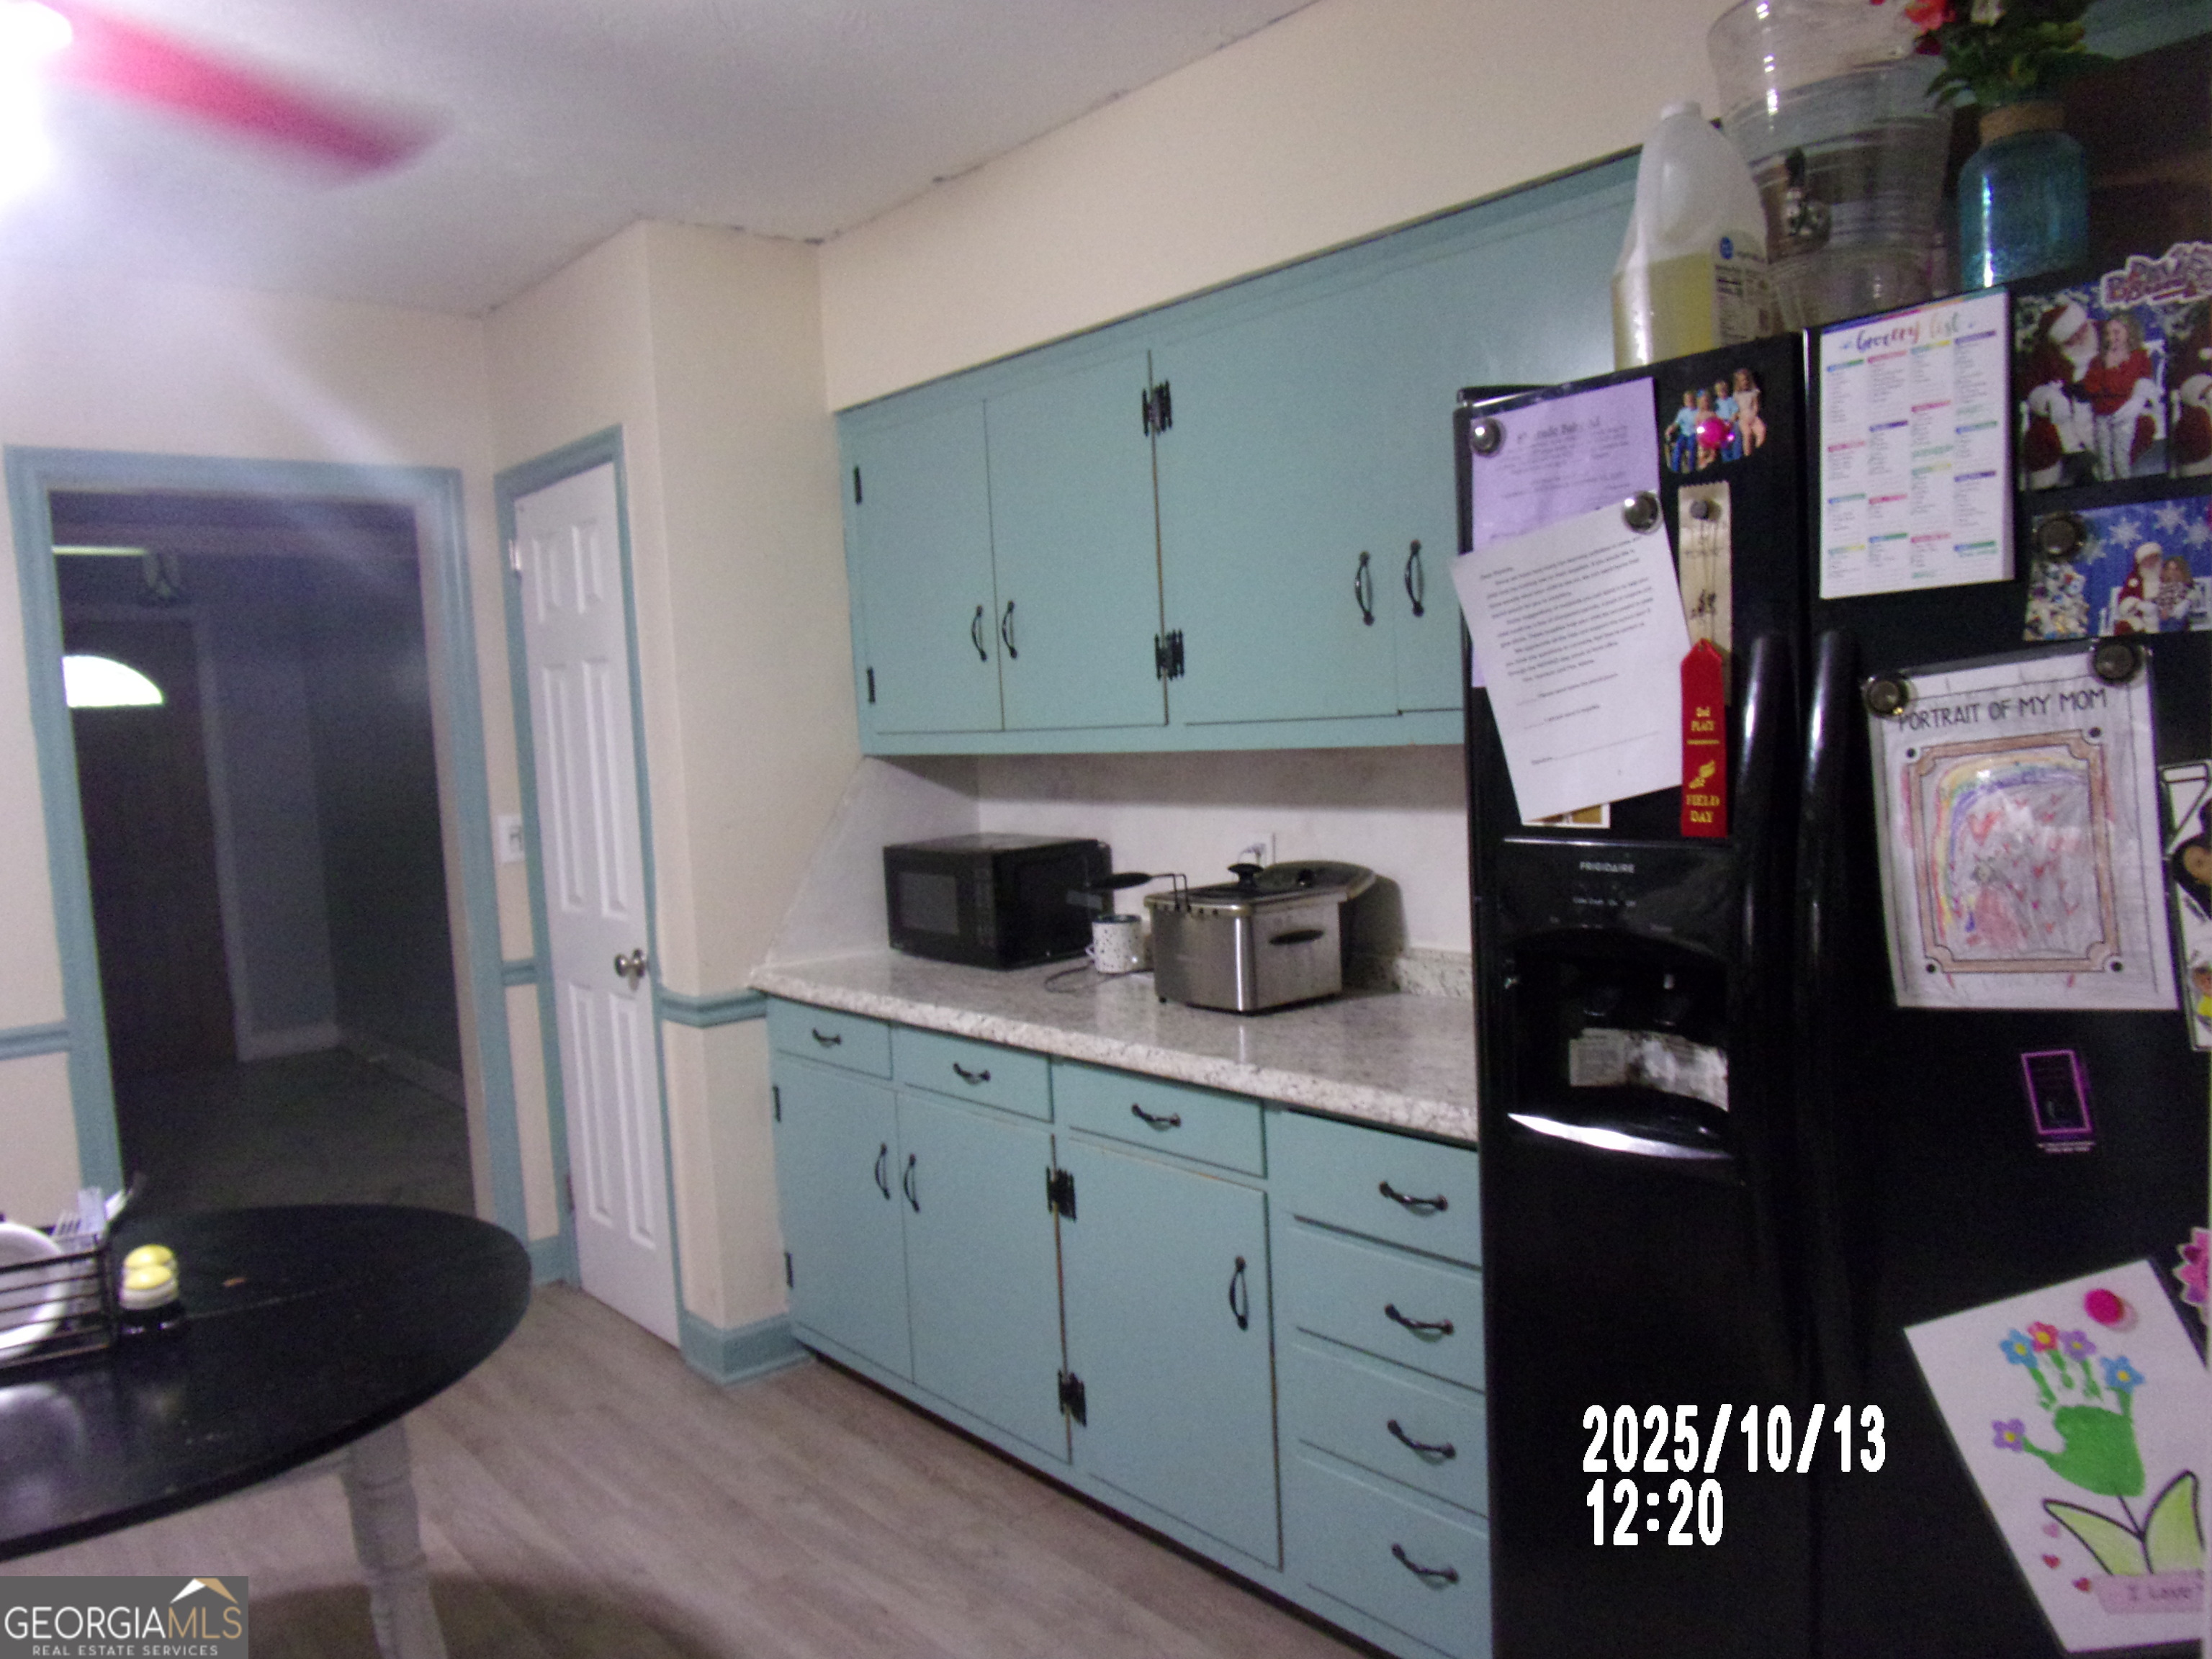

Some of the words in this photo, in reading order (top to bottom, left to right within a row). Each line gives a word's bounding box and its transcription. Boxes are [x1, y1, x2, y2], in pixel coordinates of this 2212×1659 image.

[1899, 703, 1979, 732] PORTRAIT
[1988, 698, 2012, 721] OF
[2019, 693, 2051, 717] MY
[2059, 688, 2108, 711] MOM
[1686, 793, 1720, 807] FIELD
[1690, 809, 1714, 823] DAY
